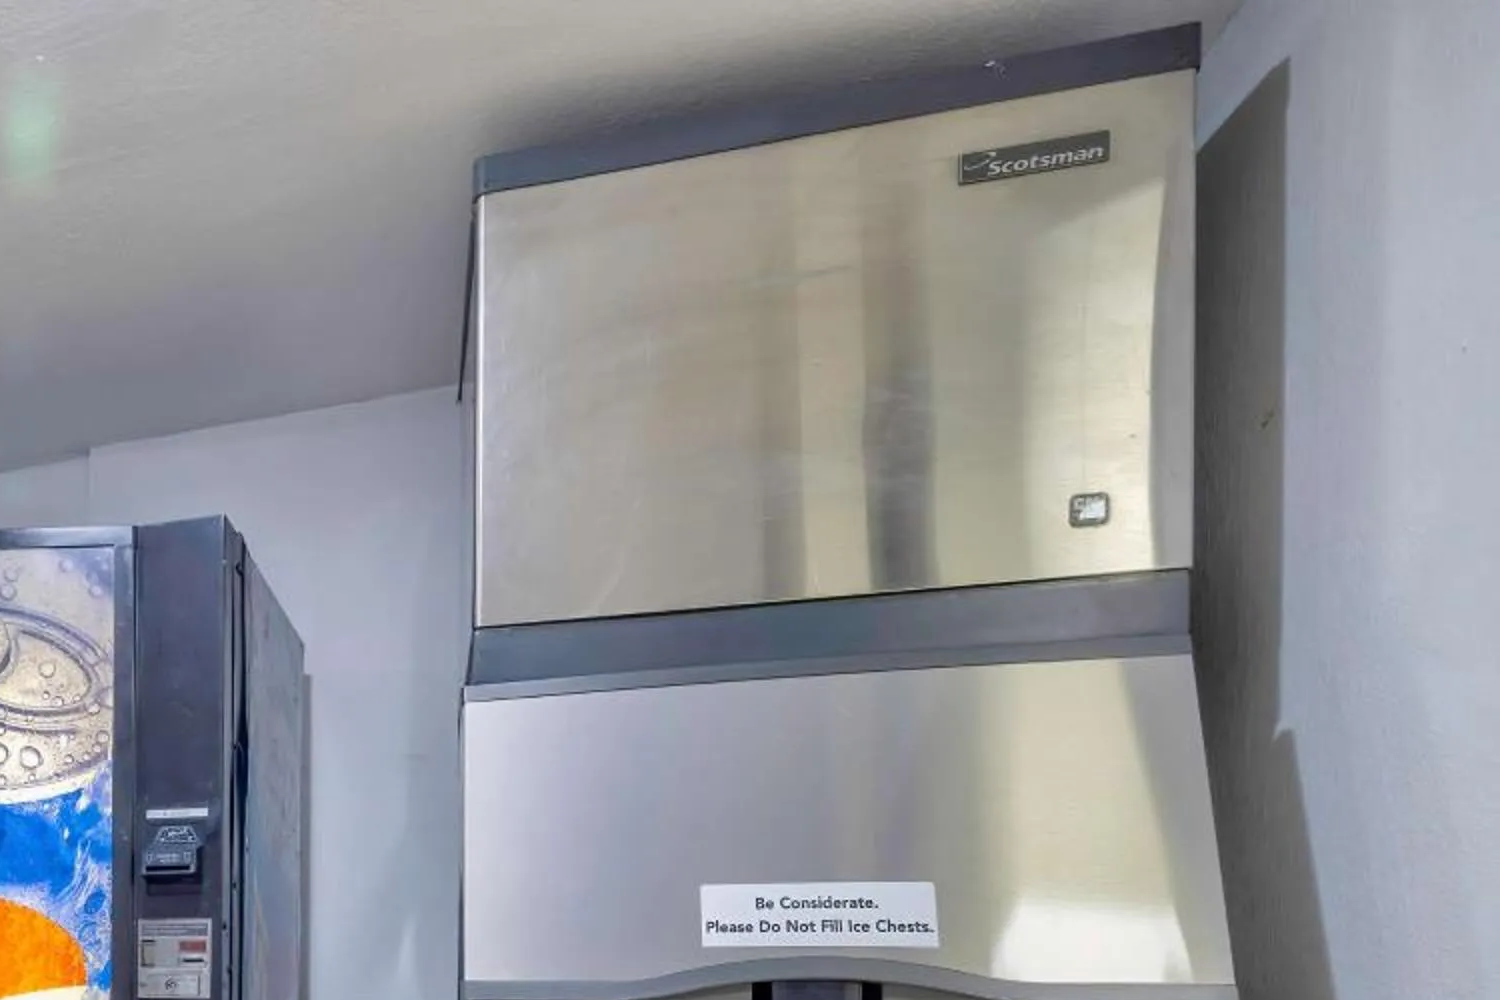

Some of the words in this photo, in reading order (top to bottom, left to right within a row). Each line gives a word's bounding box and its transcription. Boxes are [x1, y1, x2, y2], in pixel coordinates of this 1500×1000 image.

[986, 145, 1104, 176] Scotsman
[755, 897, 775, 910] Be
[779, 896, 879, 910] Considerate.
[705, 920, 754, 934] Please
[759, 920, 781, 933] Do
[786, 920, 817, 933] Not
[821, 919, 843, 933] Fill
[848, 919, 870, 933] Ice
[875, 919, 936, 934] Chests.
